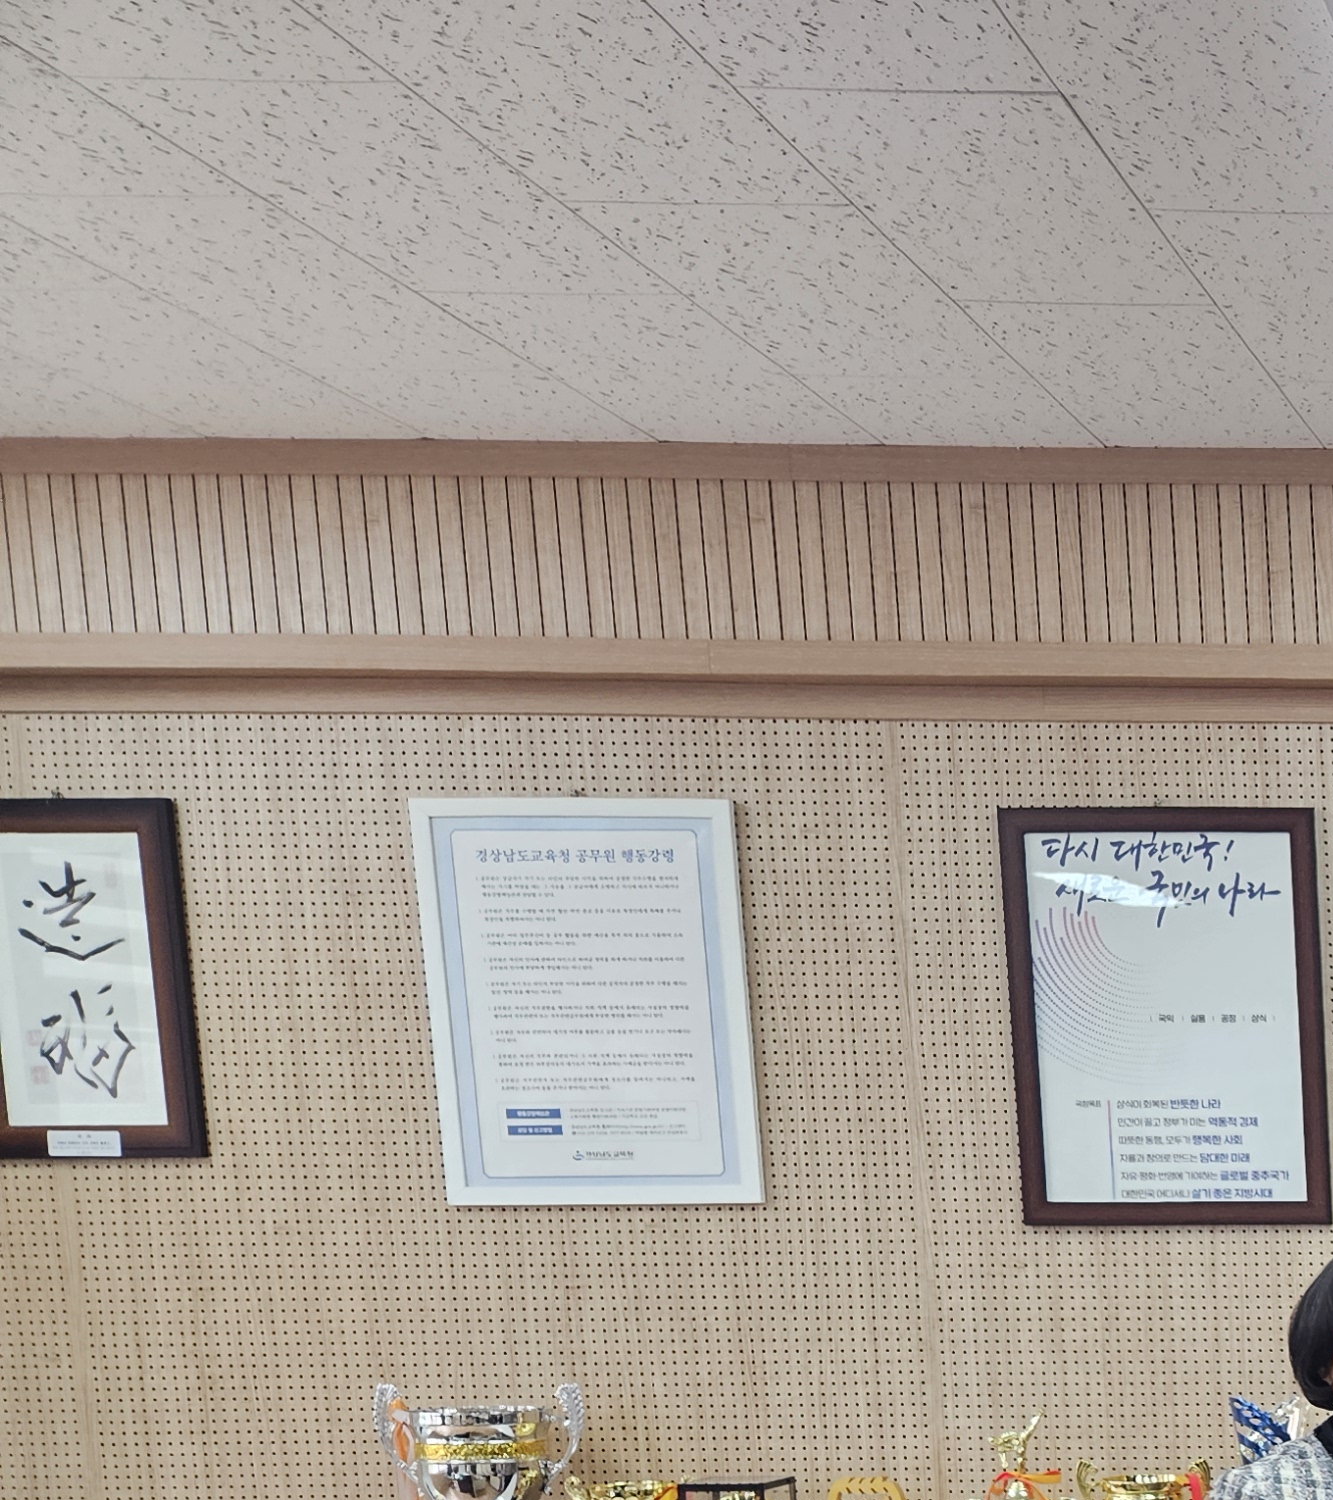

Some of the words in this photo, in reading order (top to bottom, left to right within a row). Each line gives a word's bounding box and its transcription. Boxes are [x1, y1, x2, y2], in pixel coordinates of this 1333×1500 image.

[476, 849, 570, 863] 경상남도교육청
[575, 850, 616, 863] 공무원
[622, 849, 674, 863] 행동강령
[1041, 833, 1098, 867] 다시
[1110, 832, 1234, 871] 대한민국!
[1219, 872, 1281, 916] 나라
[1170, 1099, 1199, 1109] 반듯한
[1201, 1099, 1221, 1109] 나라
[1193, 1135, 1221, 1145] 행복한
[1224, 1135, 1243, 1145] 사회
[1231, 1153, 1250, 1163] 미래
